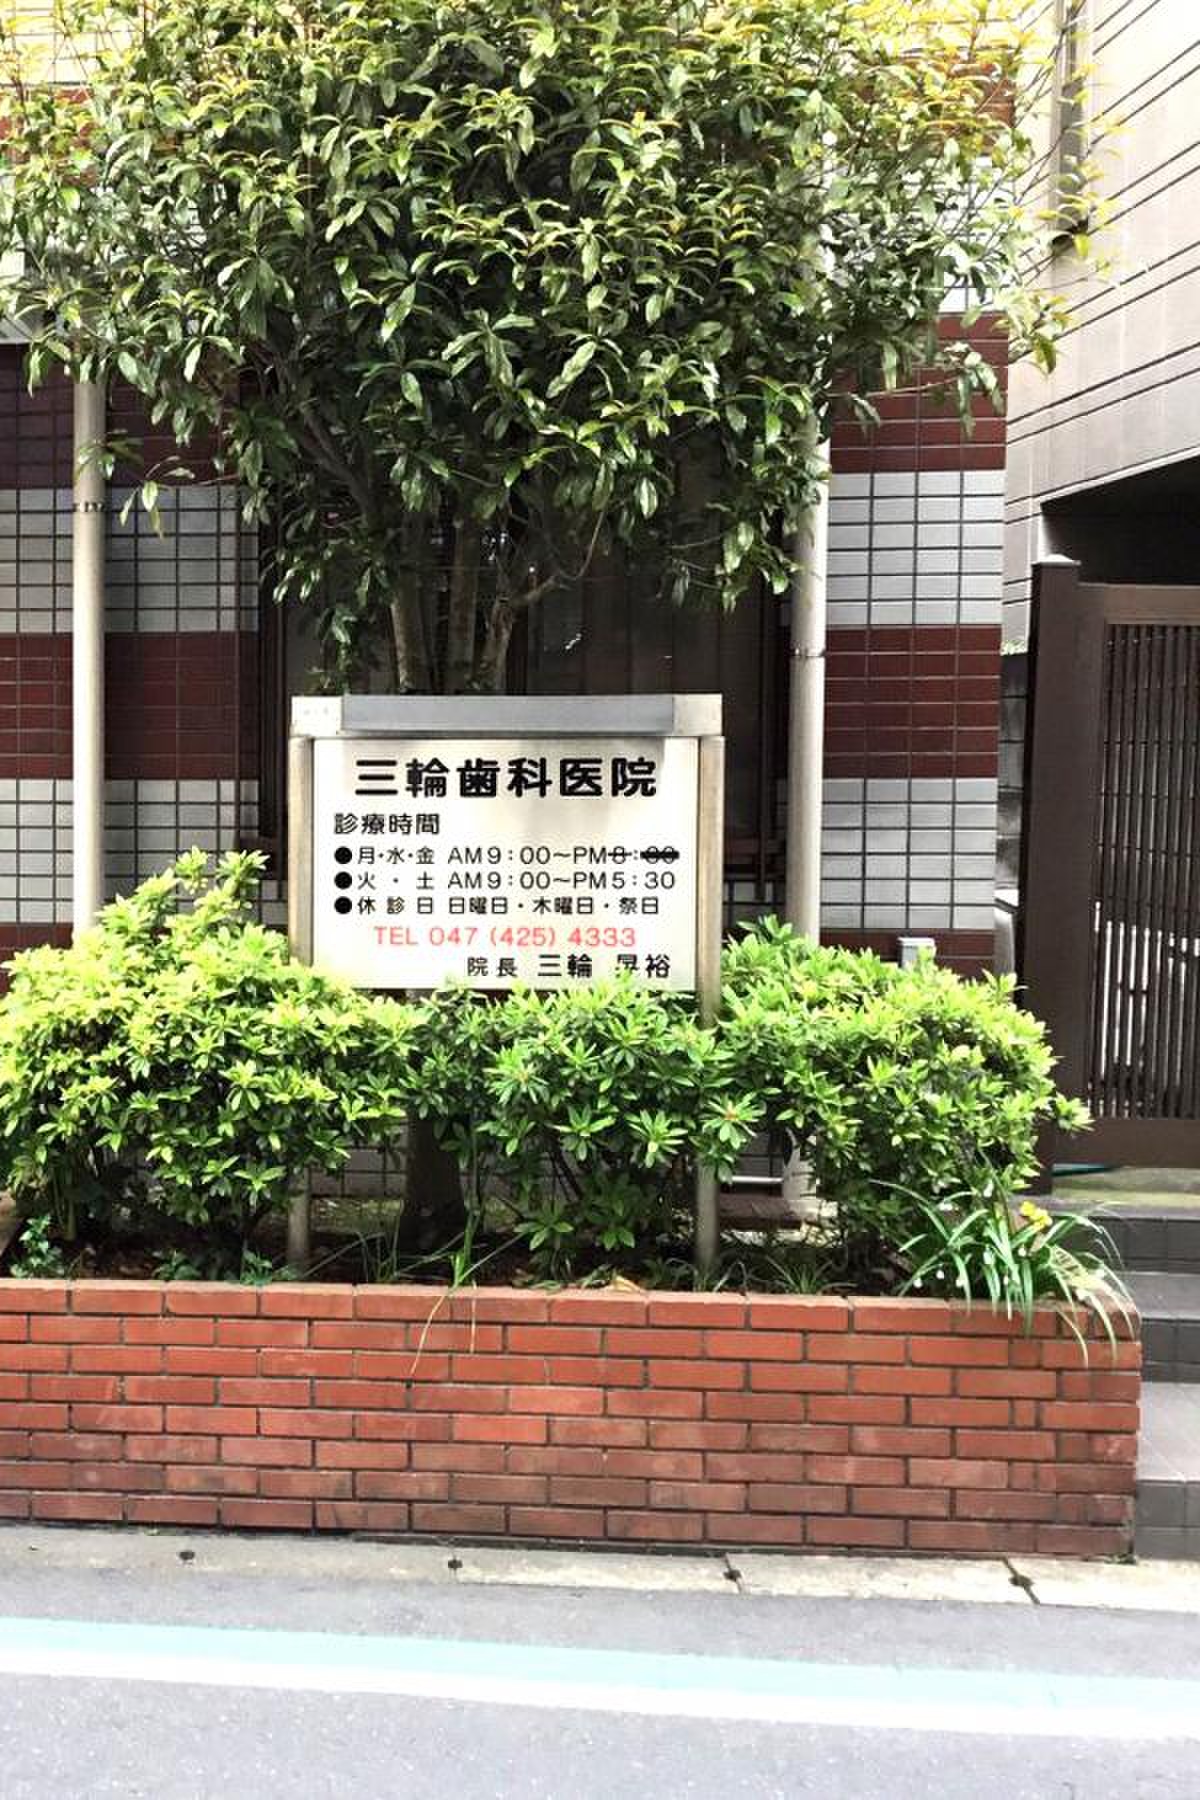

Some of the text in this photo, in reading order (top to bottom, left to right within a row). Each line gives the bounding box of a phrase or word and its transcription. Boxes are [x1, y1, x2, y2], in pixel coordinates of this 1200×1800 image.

[354, 756, 658, 798] 三輪歯科医院
[333, 812, 441, 835] 診療時間
[373, 926, 419, 946] TEL
[428, 926, 478, 946] 047
[567, 926, 636, 947] 4333
[466, 956, 519, 978] 院長
[537, 953, 593, 978] 三輪
